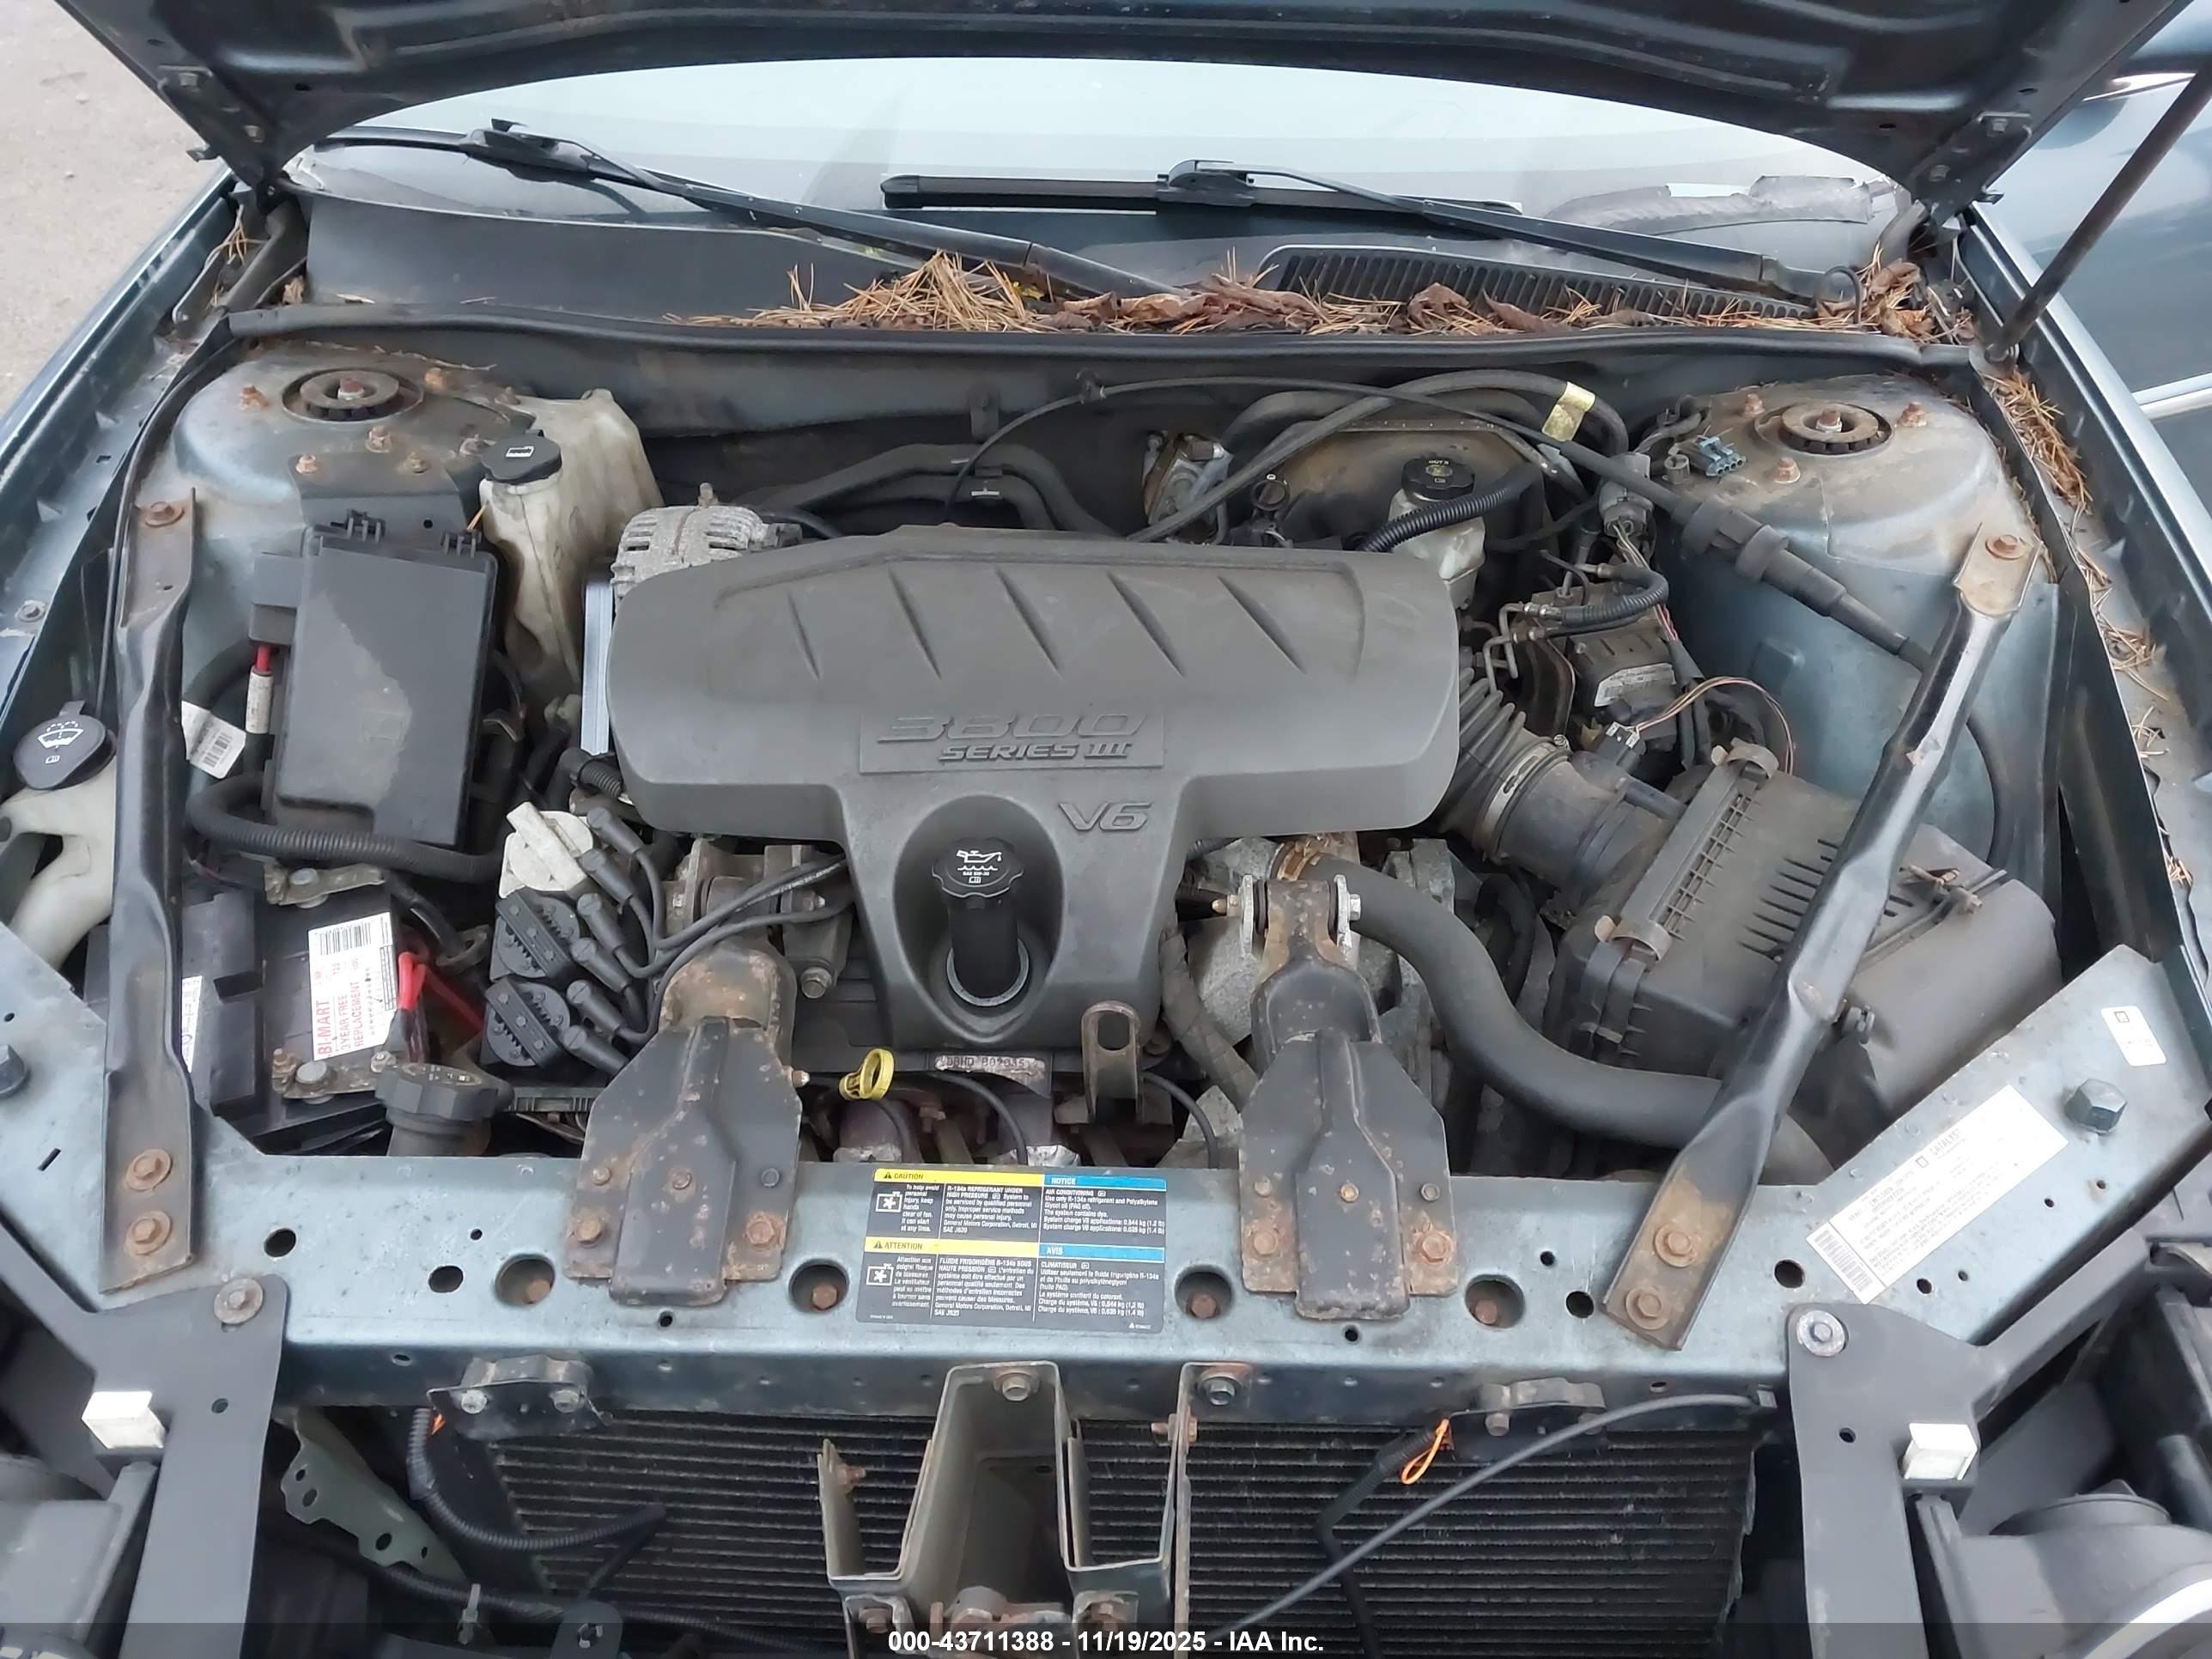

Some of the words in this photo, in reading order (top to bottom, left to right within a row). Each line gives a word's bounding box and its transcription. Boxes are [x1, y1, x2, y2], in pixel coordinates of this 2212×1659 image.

[878, 714, 1147, 744] 3800
[939, 743, 1082, 762] SERIES
[1085, 741, 1133, 758] III
[1058, 802, 1153, 831] V6
[338, 994, 348, 1017] FREE
[350, 981, 364, 1047] REPLACEMENT
[316, 1000, 332, 1054] BI-MART
[339, 1018, 350, 1044] YEAR
